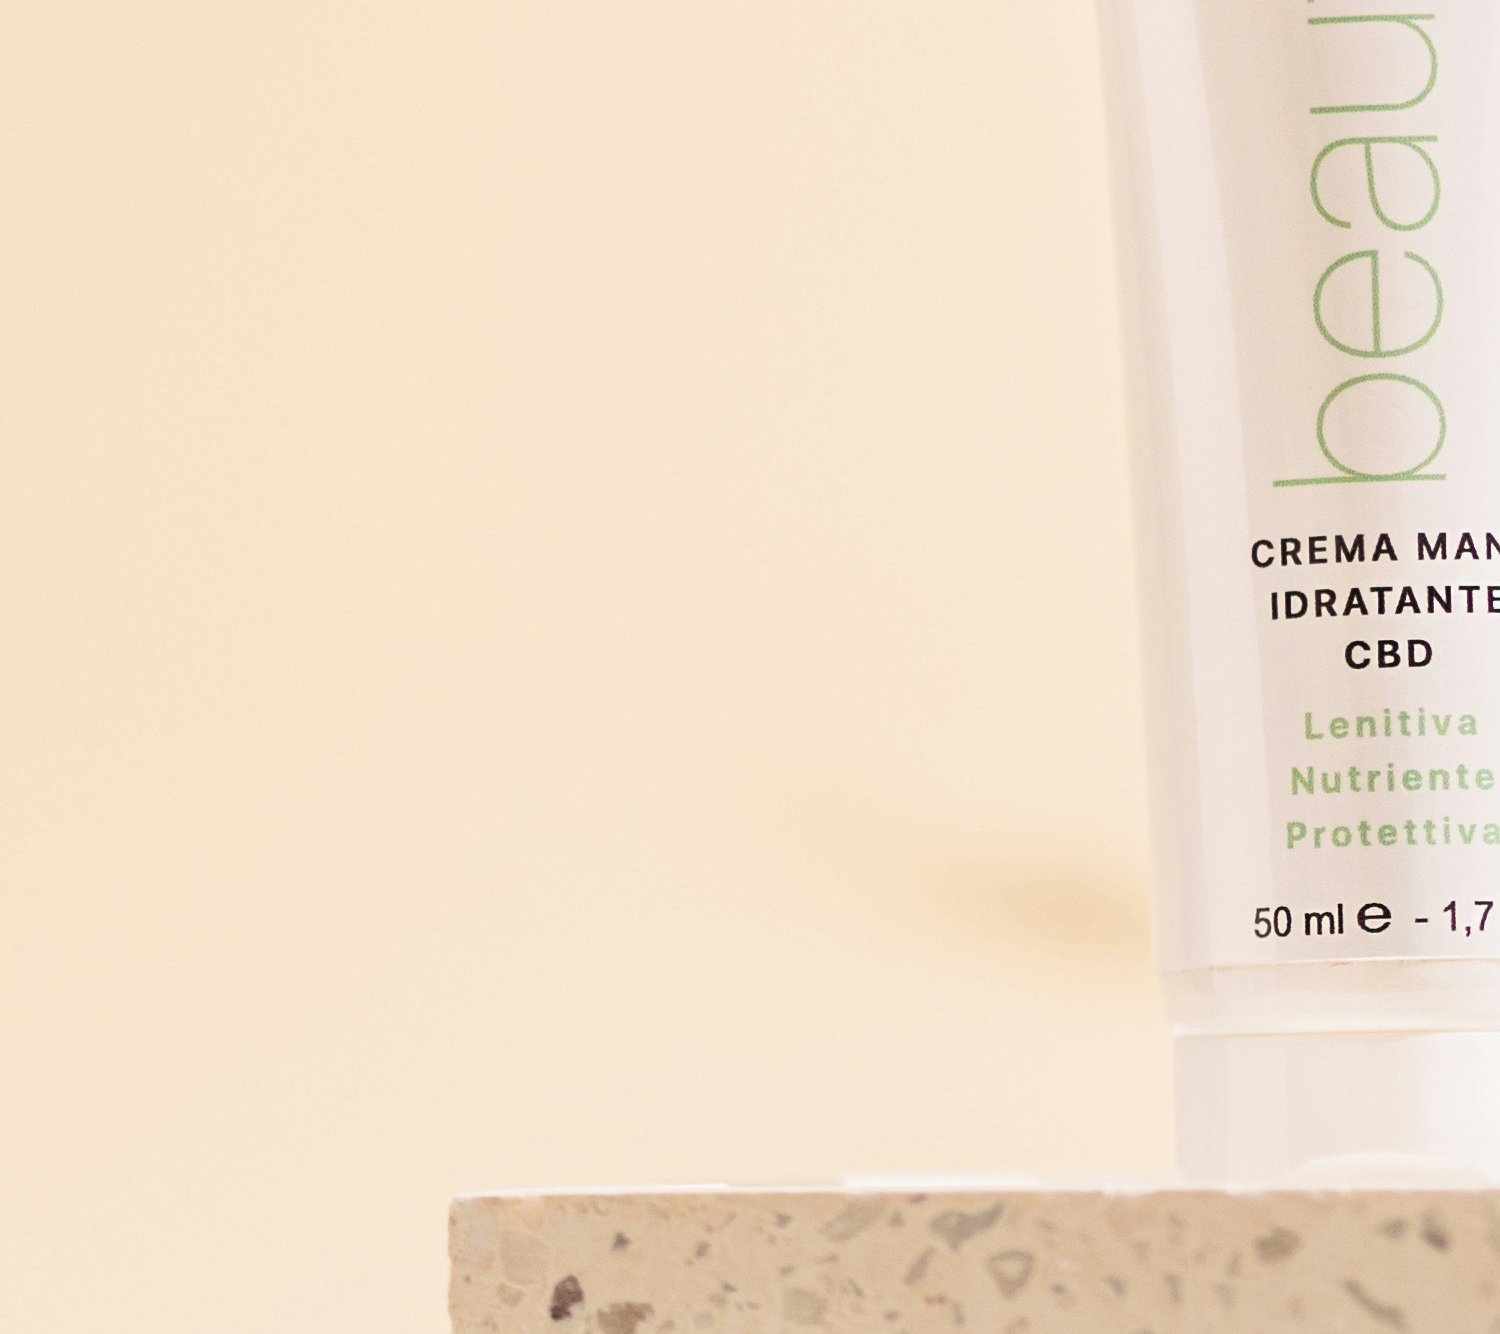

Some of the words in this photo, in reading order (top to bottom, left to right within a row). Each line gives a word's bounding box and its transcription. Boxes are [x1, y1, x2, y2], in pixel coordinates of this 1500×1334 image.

[1250, 532, 1398, 569] CREMA
[1343, 639, 1434, 670] CBD
[1303, 707, 1478, 741] Lenitiva
[1290, 762, 1496, 795] Nutriente
[1253, 906, 1293, 939] 50
[1303, 903, 1345, 936] ml
[1442, 900, 1495, 937] 1,7
